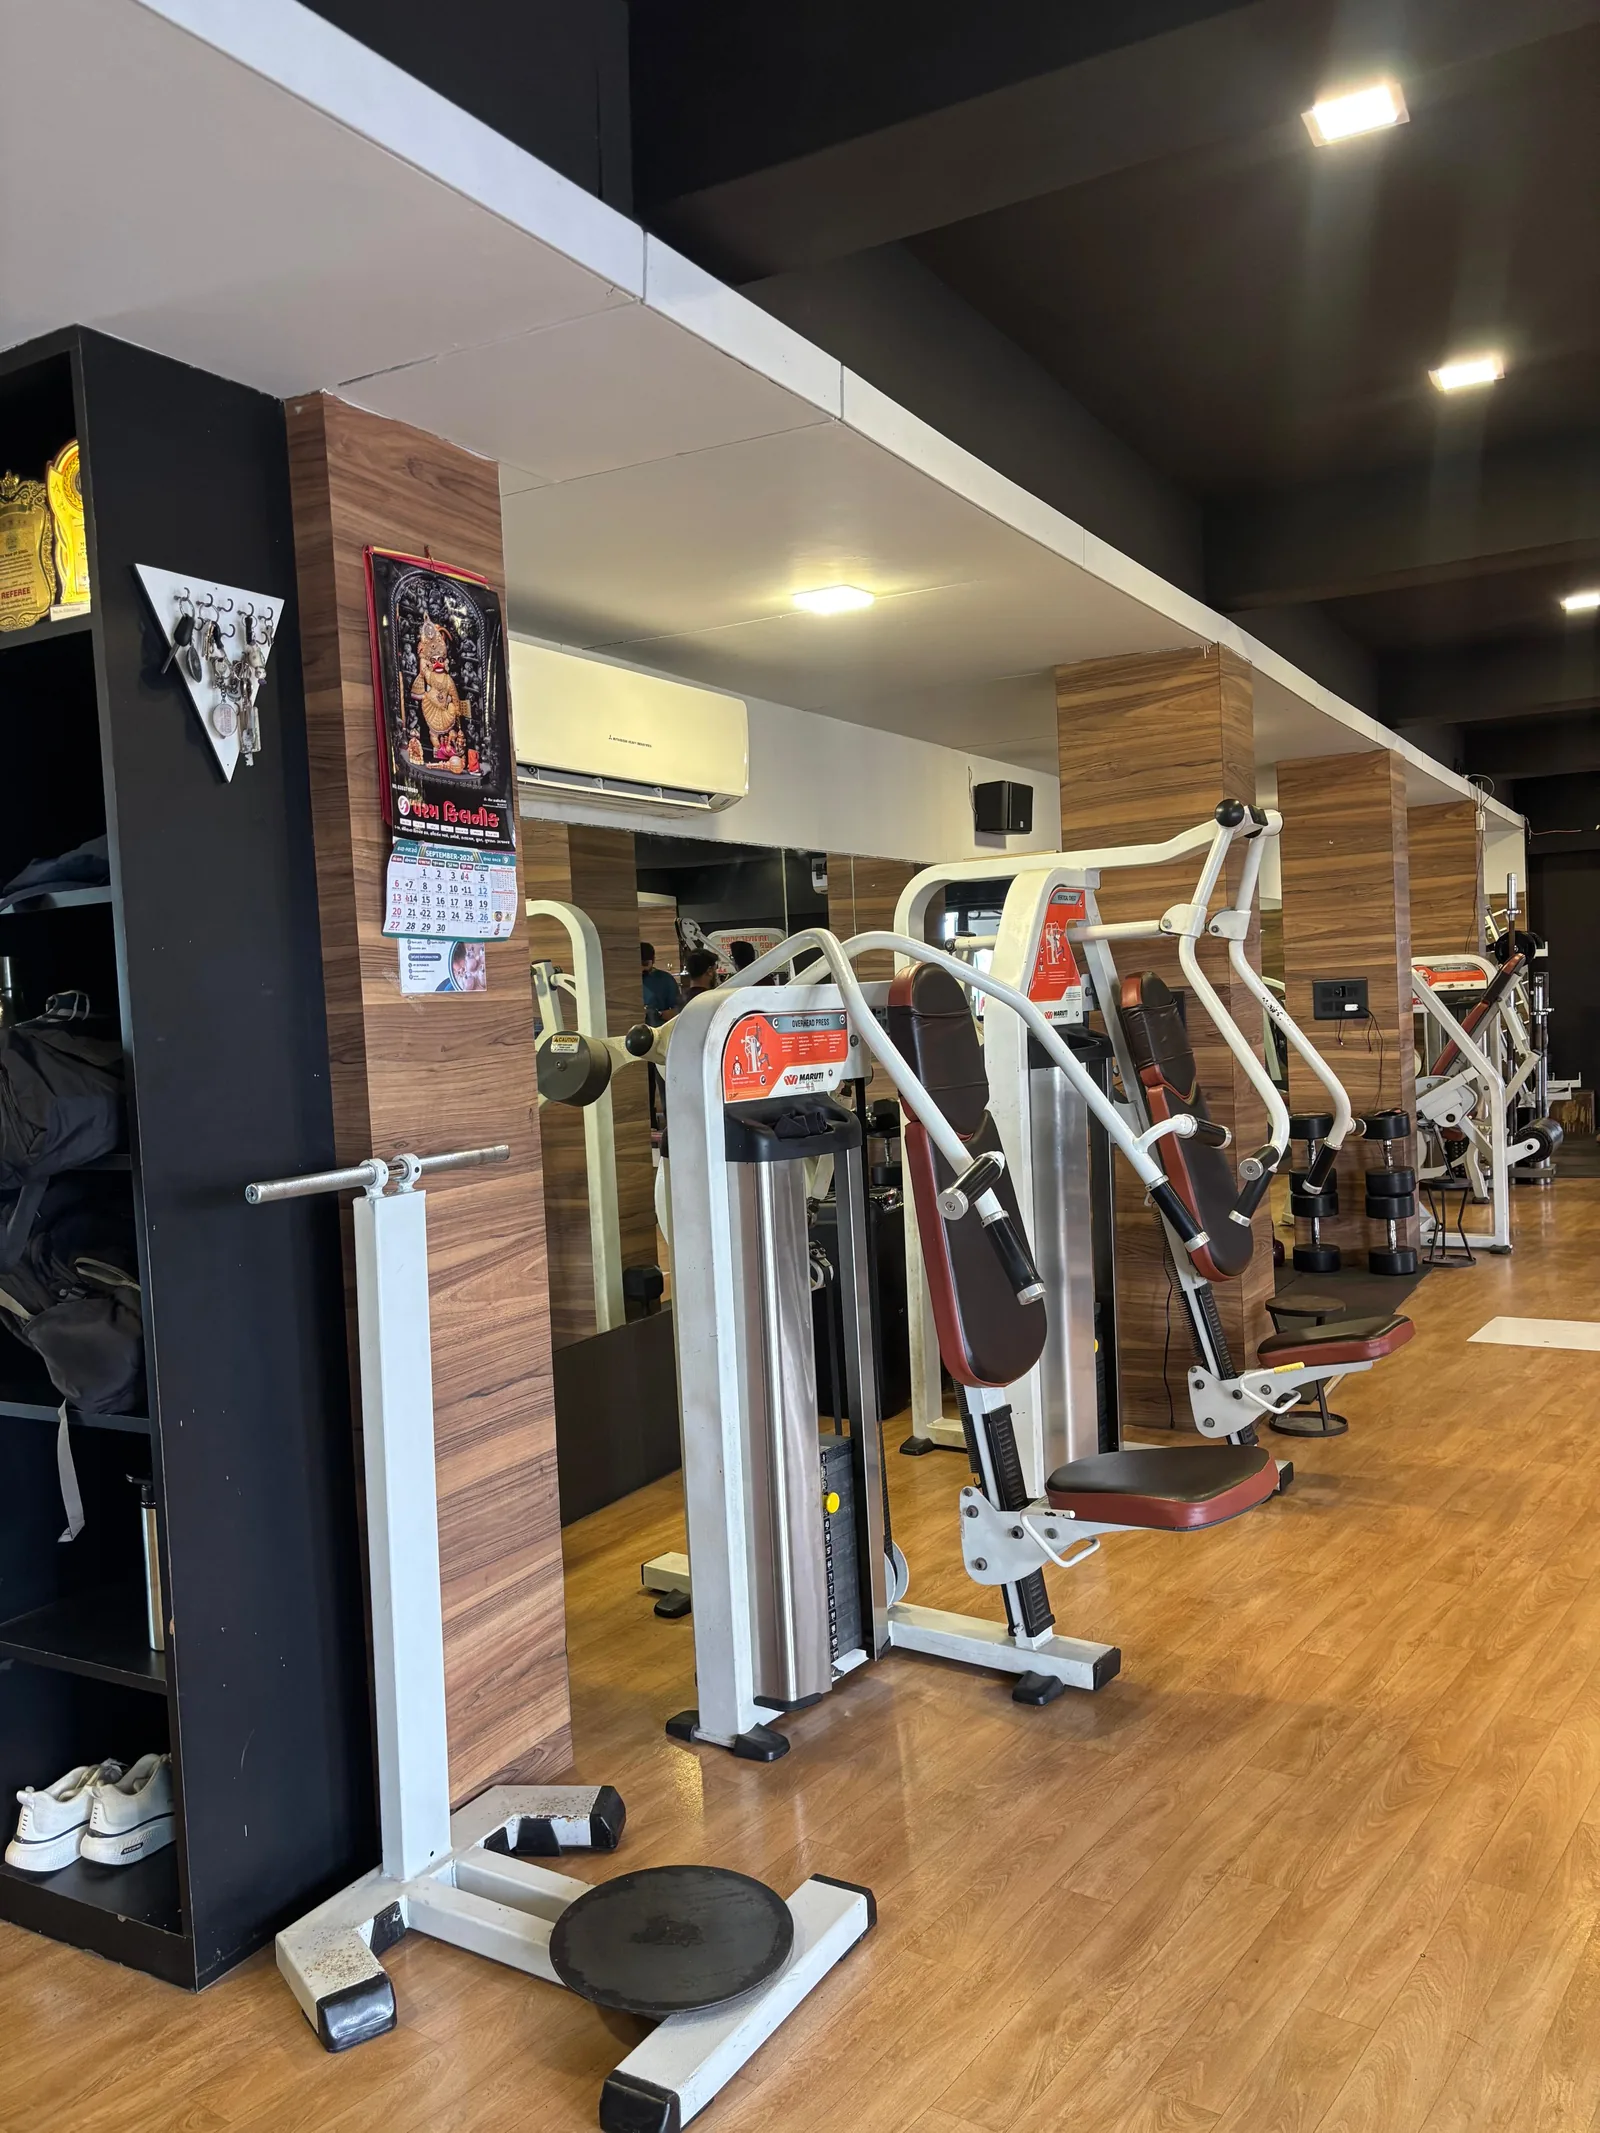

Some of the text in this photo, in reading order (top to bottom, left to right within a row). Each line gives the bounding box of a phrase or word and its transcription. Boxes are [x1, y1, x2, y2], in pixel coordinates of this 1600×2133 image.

[1, 586, 30, 600] REFEREE
[426, 850, 474, 862] SEPTEMBER-2026
[792, 1018, 830, 1028] OVERHEAD PRESS
[799, 1072, 824, 1081] MARUTI
